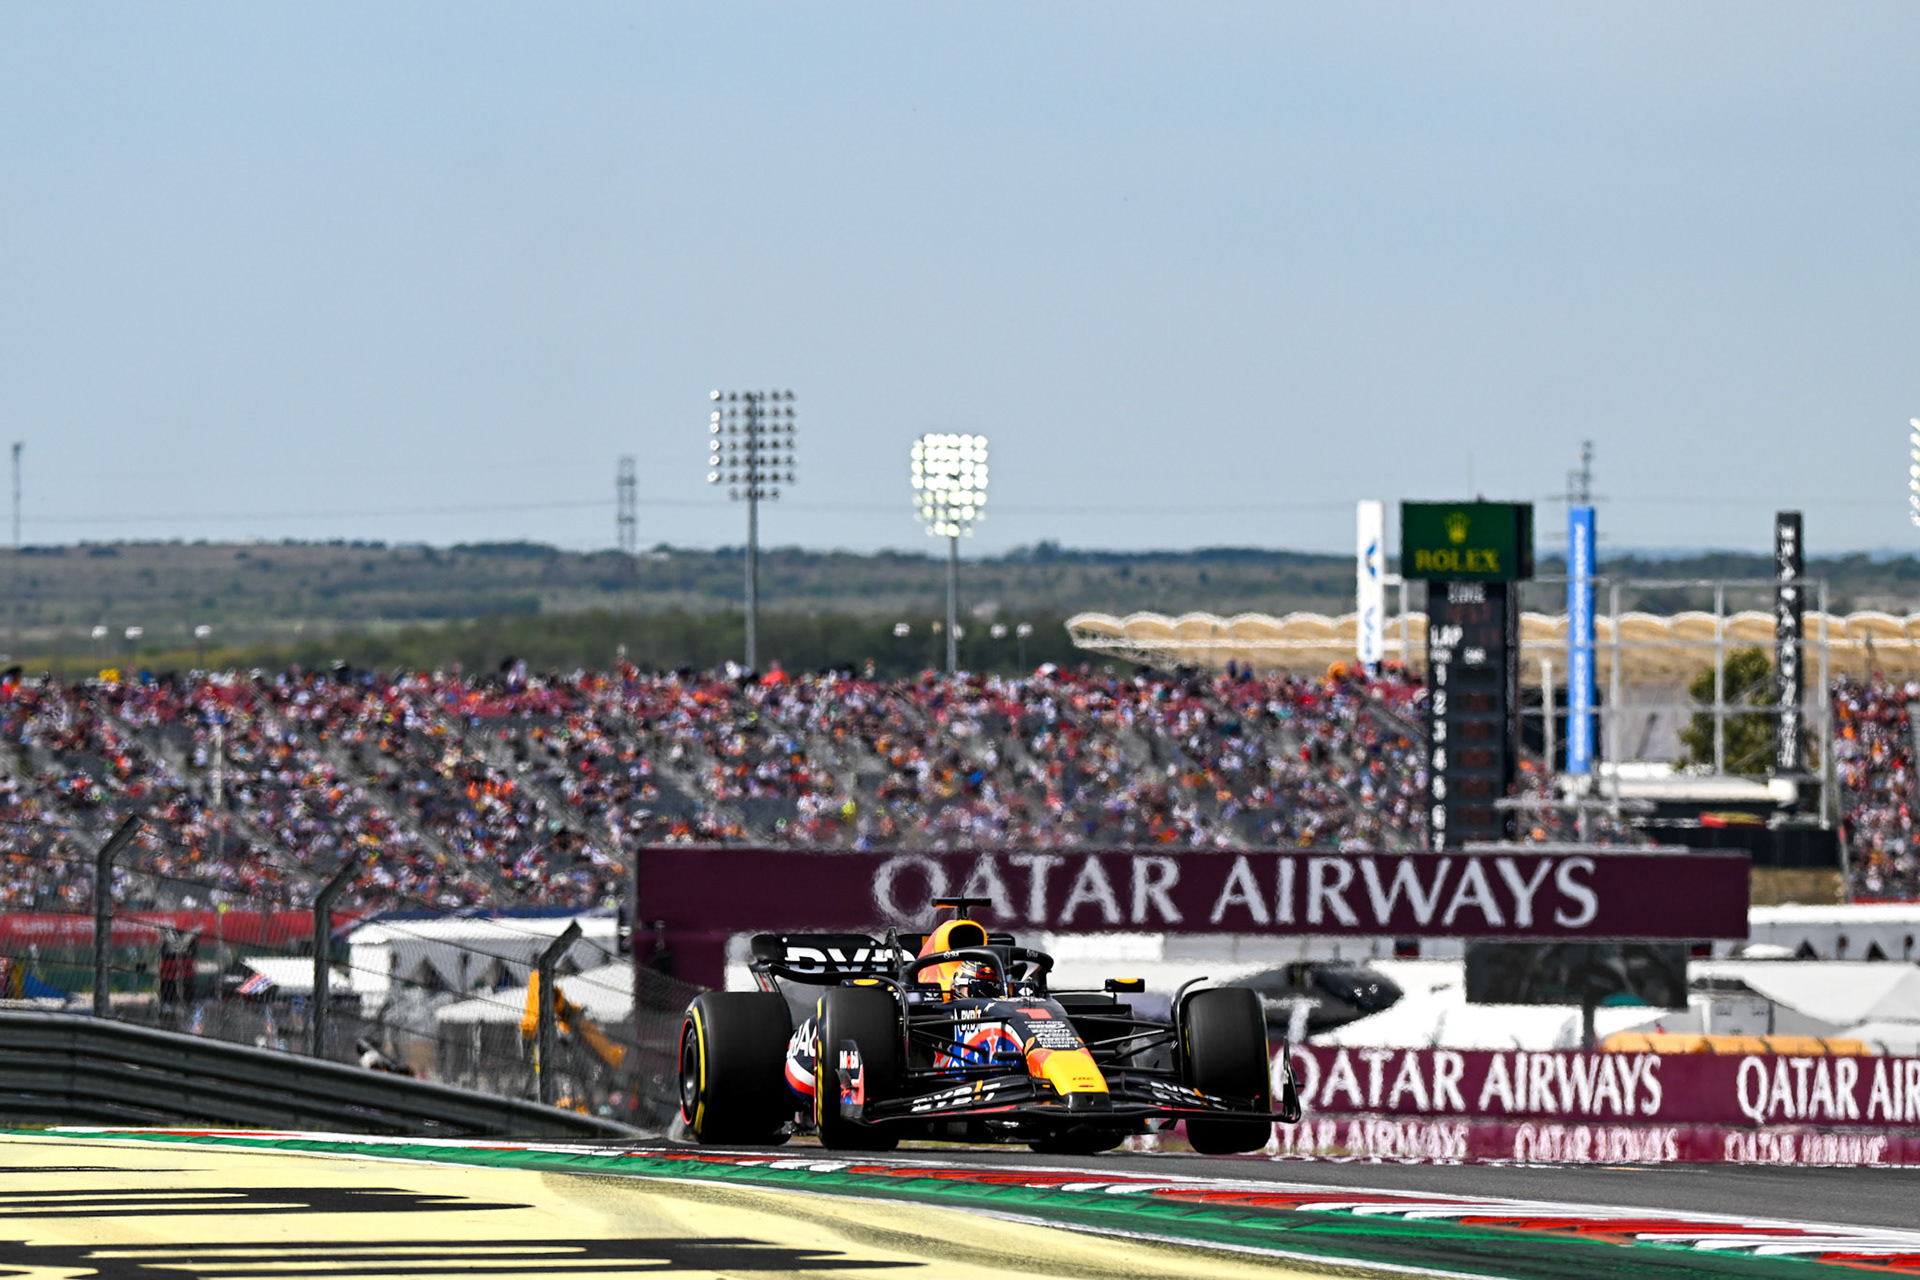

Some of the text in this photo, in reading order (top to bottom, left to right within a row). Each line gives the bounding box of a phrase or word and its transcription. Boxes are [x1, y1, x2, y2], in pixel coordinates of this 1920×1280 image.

[1415, 549, 1499, 572] ROLEX
[1432, 689, 1447, 715] 2
[1432, 719, 1447, 742] 3
[873, 853, 1599, 929] QATAR AIRWAYS
[1015, 1008, 1052, 1019] 1
[1271, 1045, 1662, 1116] QATAR AIRWAYS
[1737, 1055, 1860, 1123] QATAR
[1264, 1119, 1469, 1158] ATAR AIRWAYS
